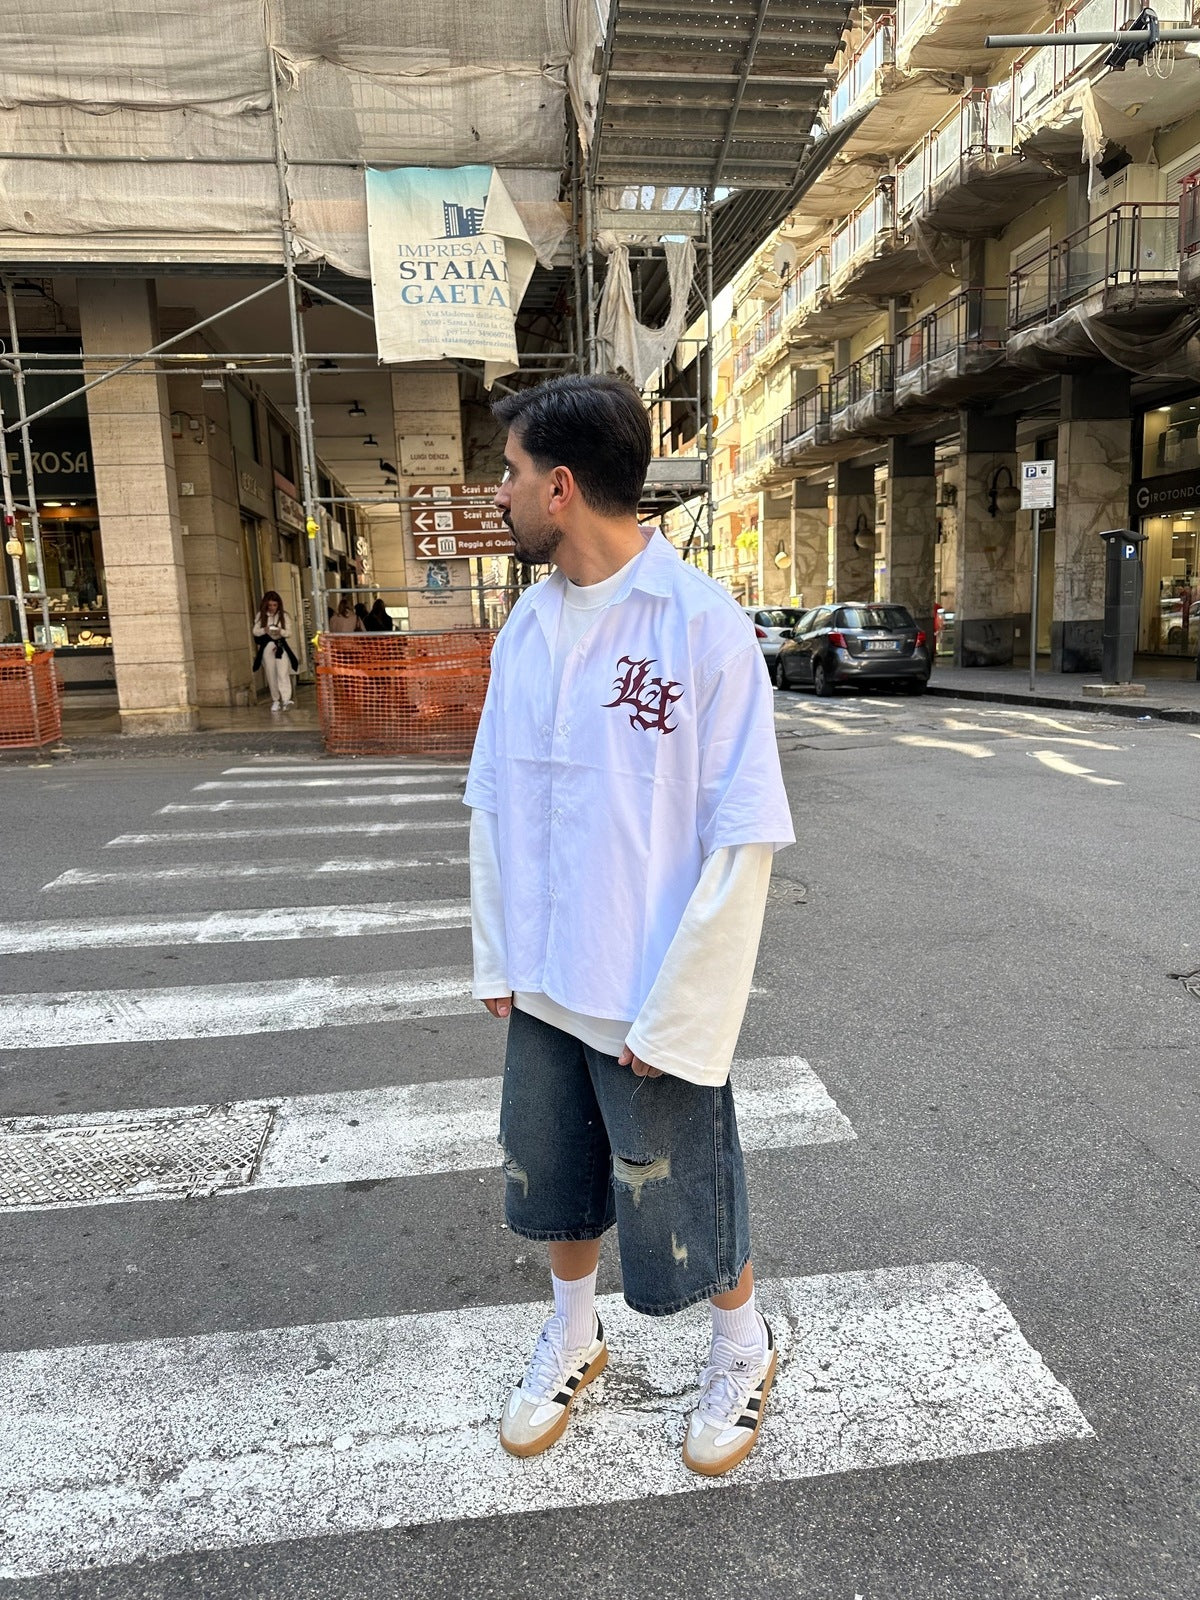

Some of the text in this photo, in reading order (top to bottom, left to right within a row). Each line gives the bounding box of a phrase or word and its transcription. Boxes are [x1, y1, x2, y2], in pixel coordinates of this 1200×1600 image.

[397, 242, 487, 257] IMPRESA
[401, 285, 508, 308] GAETA
[410, 453, 427, 461] LUIGI
[461, 484, 481, 494] Scavi
[463, 510, 483, 519] Scavi
[480, 520, 499, 529] Villa
[458, 540, 484, 549] Reggia
